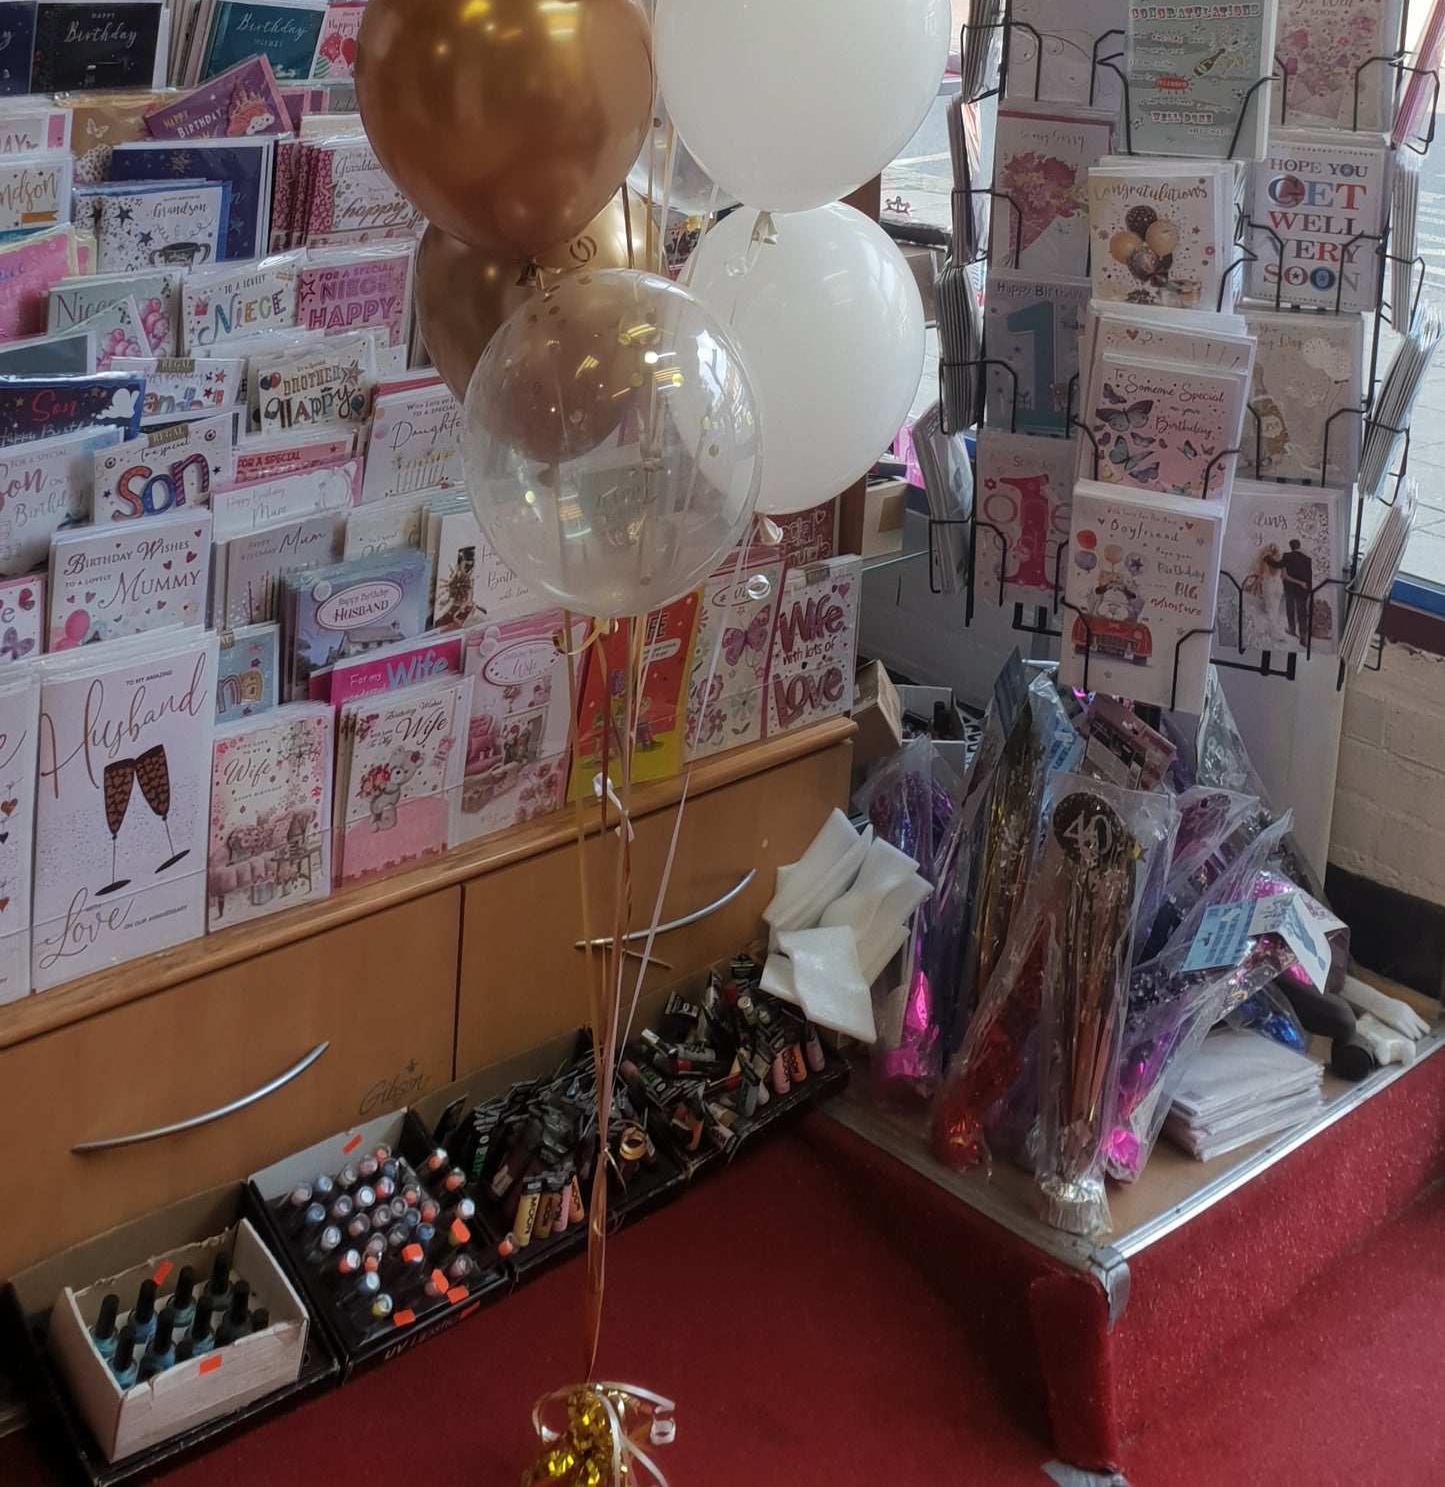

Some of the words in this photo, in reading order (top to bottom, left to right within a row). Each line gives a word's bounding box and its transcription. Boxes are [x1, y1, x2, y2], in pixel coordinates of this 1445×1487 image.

[64, 20, 138, 49] Birthday
[1270, 159, 1321, 174] HOPE
[1329, 163, 1369, 178] YOU
[1267, 174, 1367, 211] GET
[153, 201, 208, 218] Grandson
[1267, 211, 1364, 236] WELL
[1266, 236, 1363, 263] VERY
[996, 282, 1031, 296] Happy
[1263, 263, 1361, 292] SOON
[308, 296, 396, 329] HAPPY
[1125, 375, 1176, 397] Someone
[1178, 383, 1225, 403] Special
[31, 389, 78, 422] Son
[153, 427, 184, 443] REGAL
[390, 414, 463, 451] Daughte
[1155, 416, 1213, 439] Birthday
[237, 455, 254, 468] FOR
[256, 454, 263, 465] A
[265, 451, 301, 463] SPECIAL
[112, 453, 210, 522] Son
[1111, 518, 1180, 542] Boyfriend
[1174, 582, 1198, 600] BIG
[779, 594, 844, 653] Wife
[387, 651, 448, 690] Wife
[41, 651, 207, 799] Husband
[395, 707, 448, 746] Wife
[224, 757, 272, 788] Wife
[36, 887, 135, 969] Love
[525, 1197, 538, 1234] MOON
